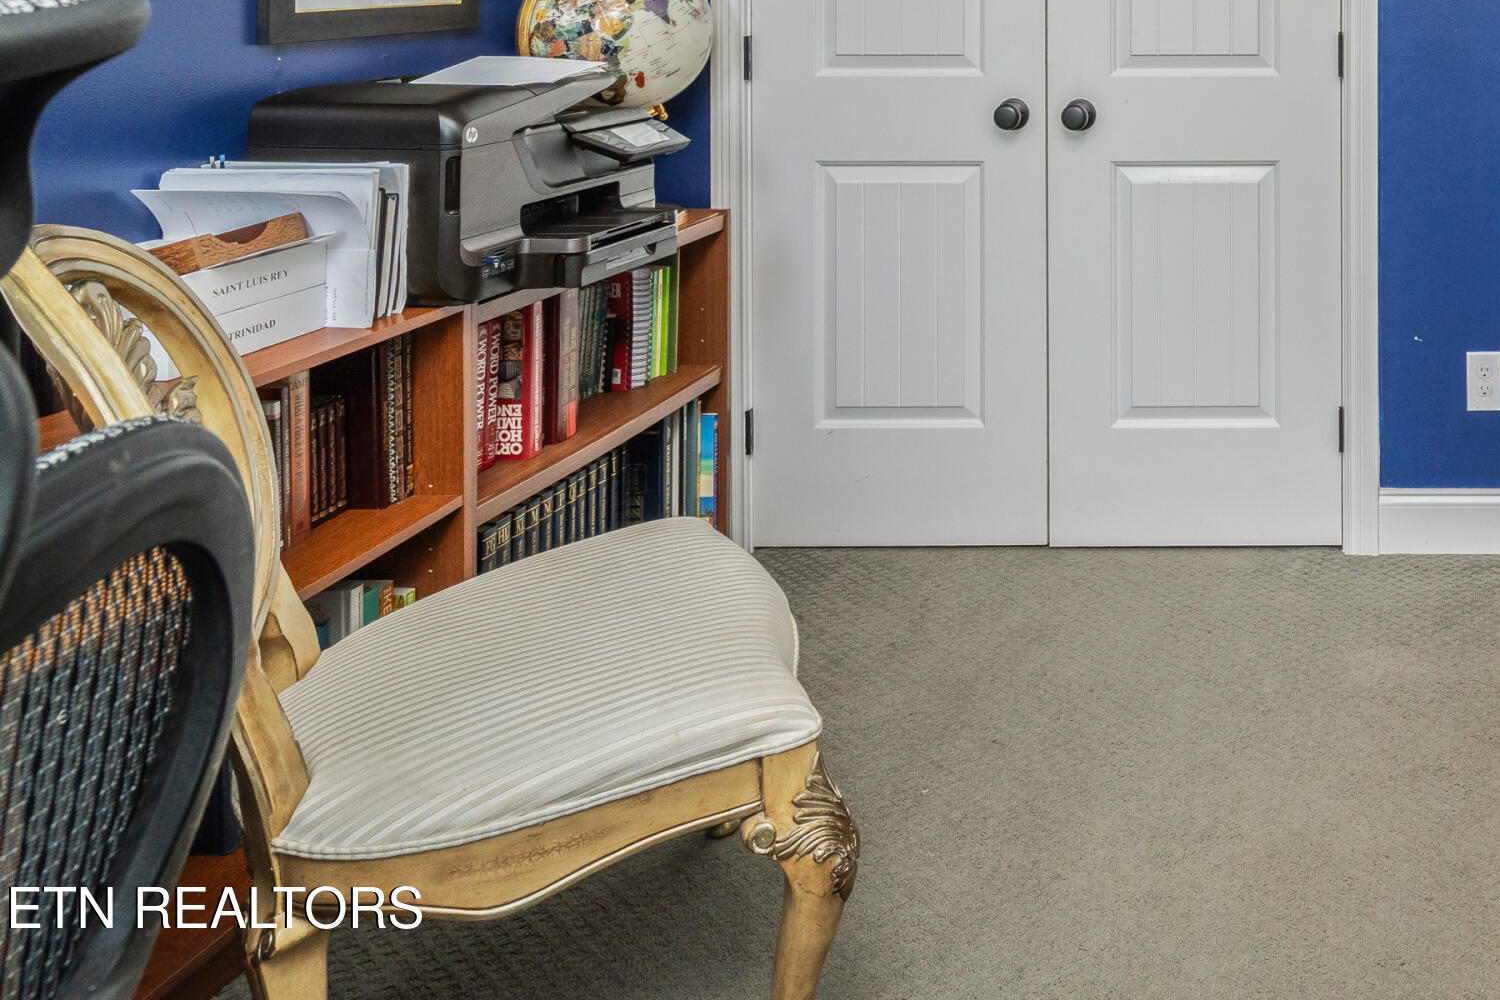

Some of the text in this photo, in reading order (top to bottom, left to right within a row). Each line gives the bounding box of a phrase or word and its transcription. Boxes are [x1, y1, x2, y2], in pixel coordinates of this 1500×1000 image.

[466, 128, 479, 143] hp
[212, 269, 289, 298] SAINT LUIS REY
[228, 320, 276, 341] TRINIDAD
[477, 338, 487, 429] WORD POWER
[487, 333, 500, 425] WORD POWER
